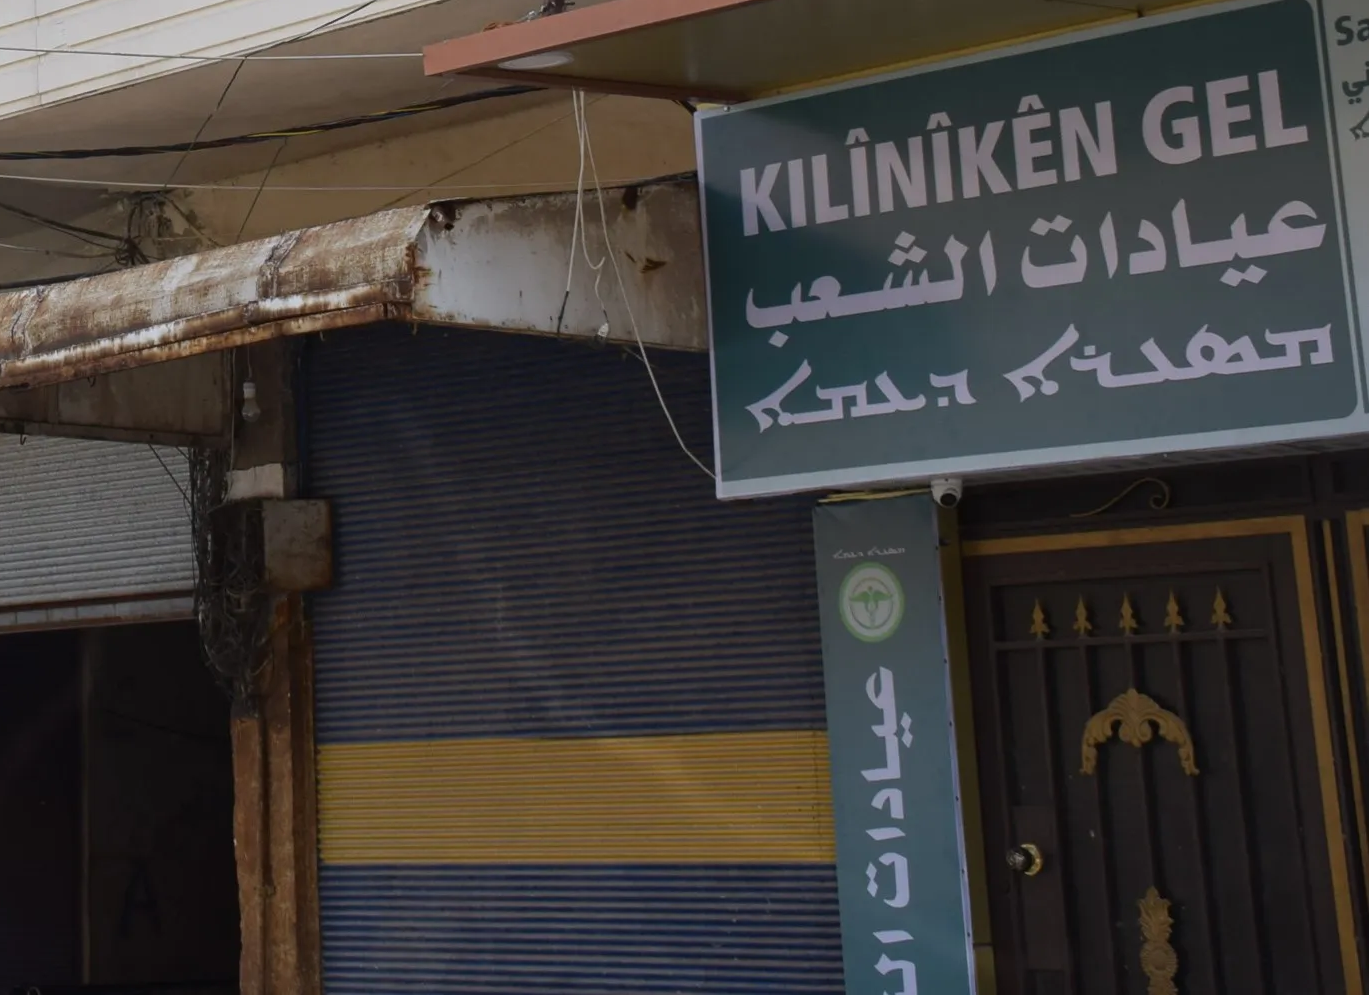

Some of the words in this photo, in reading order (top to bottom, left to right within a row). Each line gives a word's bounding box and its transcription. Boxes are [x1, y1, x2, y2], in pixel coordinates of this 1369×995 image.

[740, 94, 1116, 236] KILÎNÎKÊN
[1141, 69, 1308, 165] GEL
[745, 228, 998, 347] الشعب
[1020, 198, 1327, 290] عيادات
[861, 666, 915, 910] عيادات
